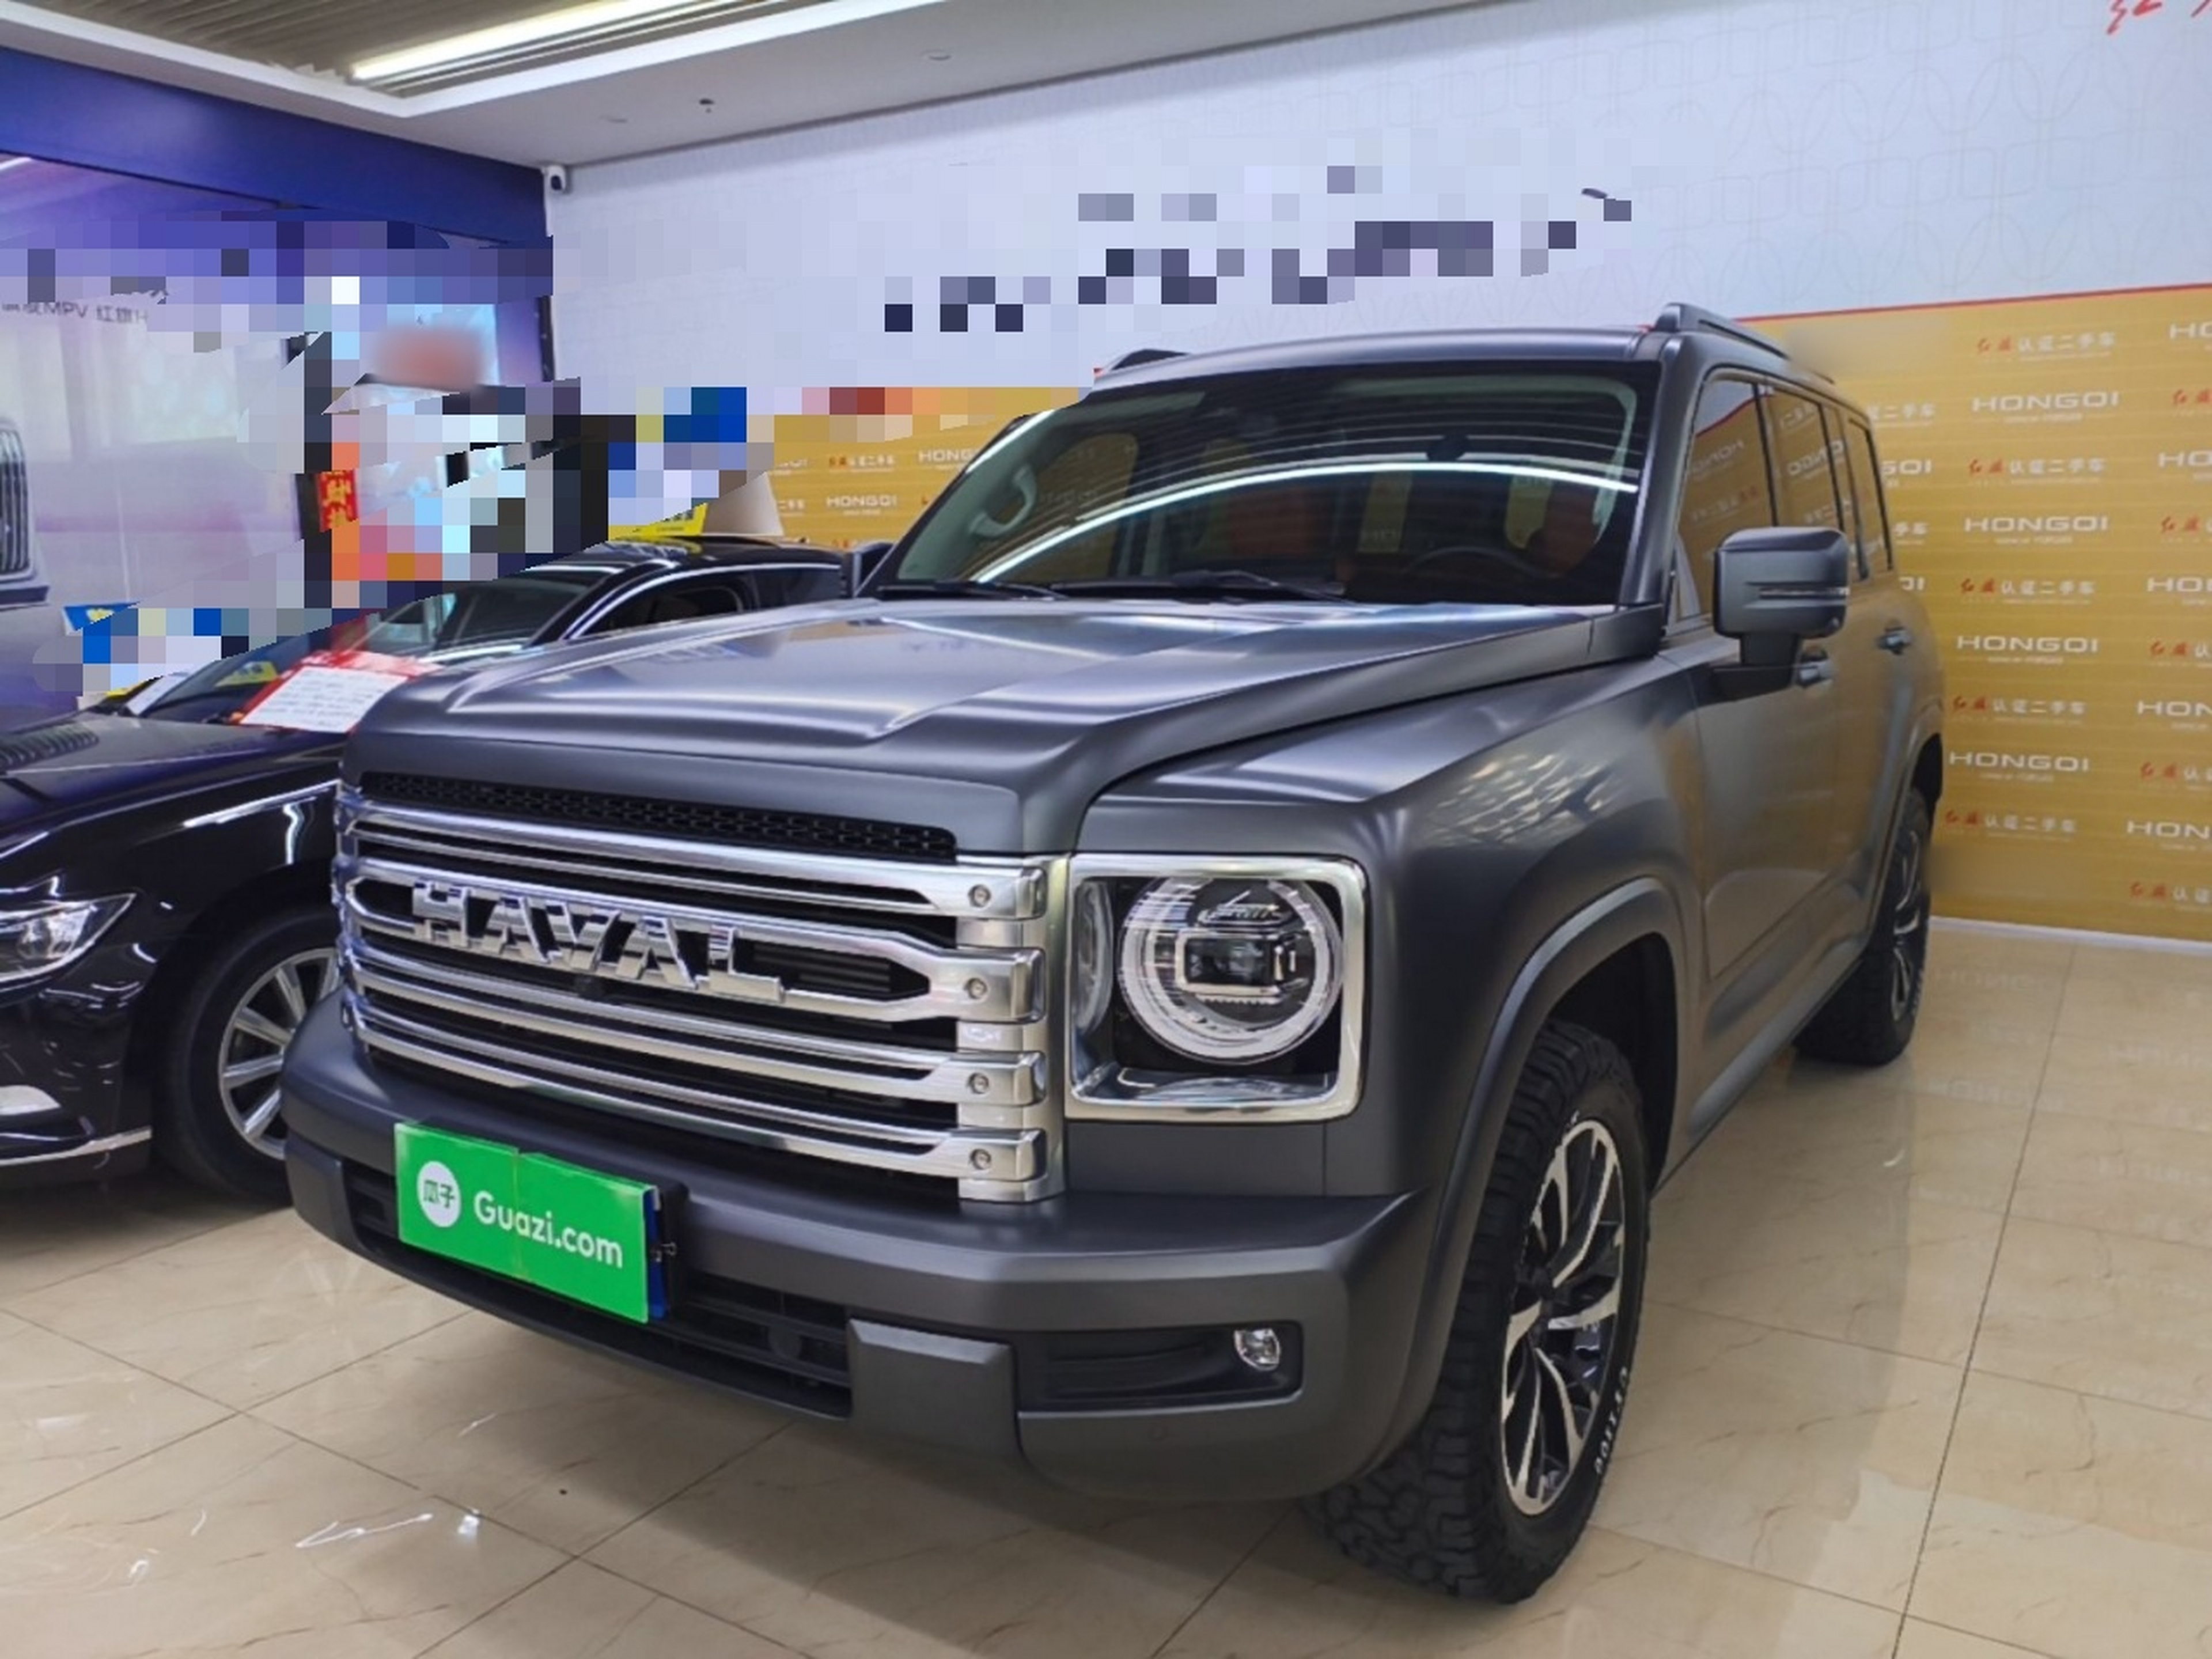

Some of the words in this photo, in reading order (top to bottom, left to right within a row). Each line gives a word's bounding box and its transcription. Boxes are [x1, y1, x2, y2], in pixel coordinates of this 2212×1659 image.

[412, 881, 782, 1002] HAVAL
[423, 1180, 455, 1209] 瓜子
[474, 1190, 623, 1269] Guazi.com
